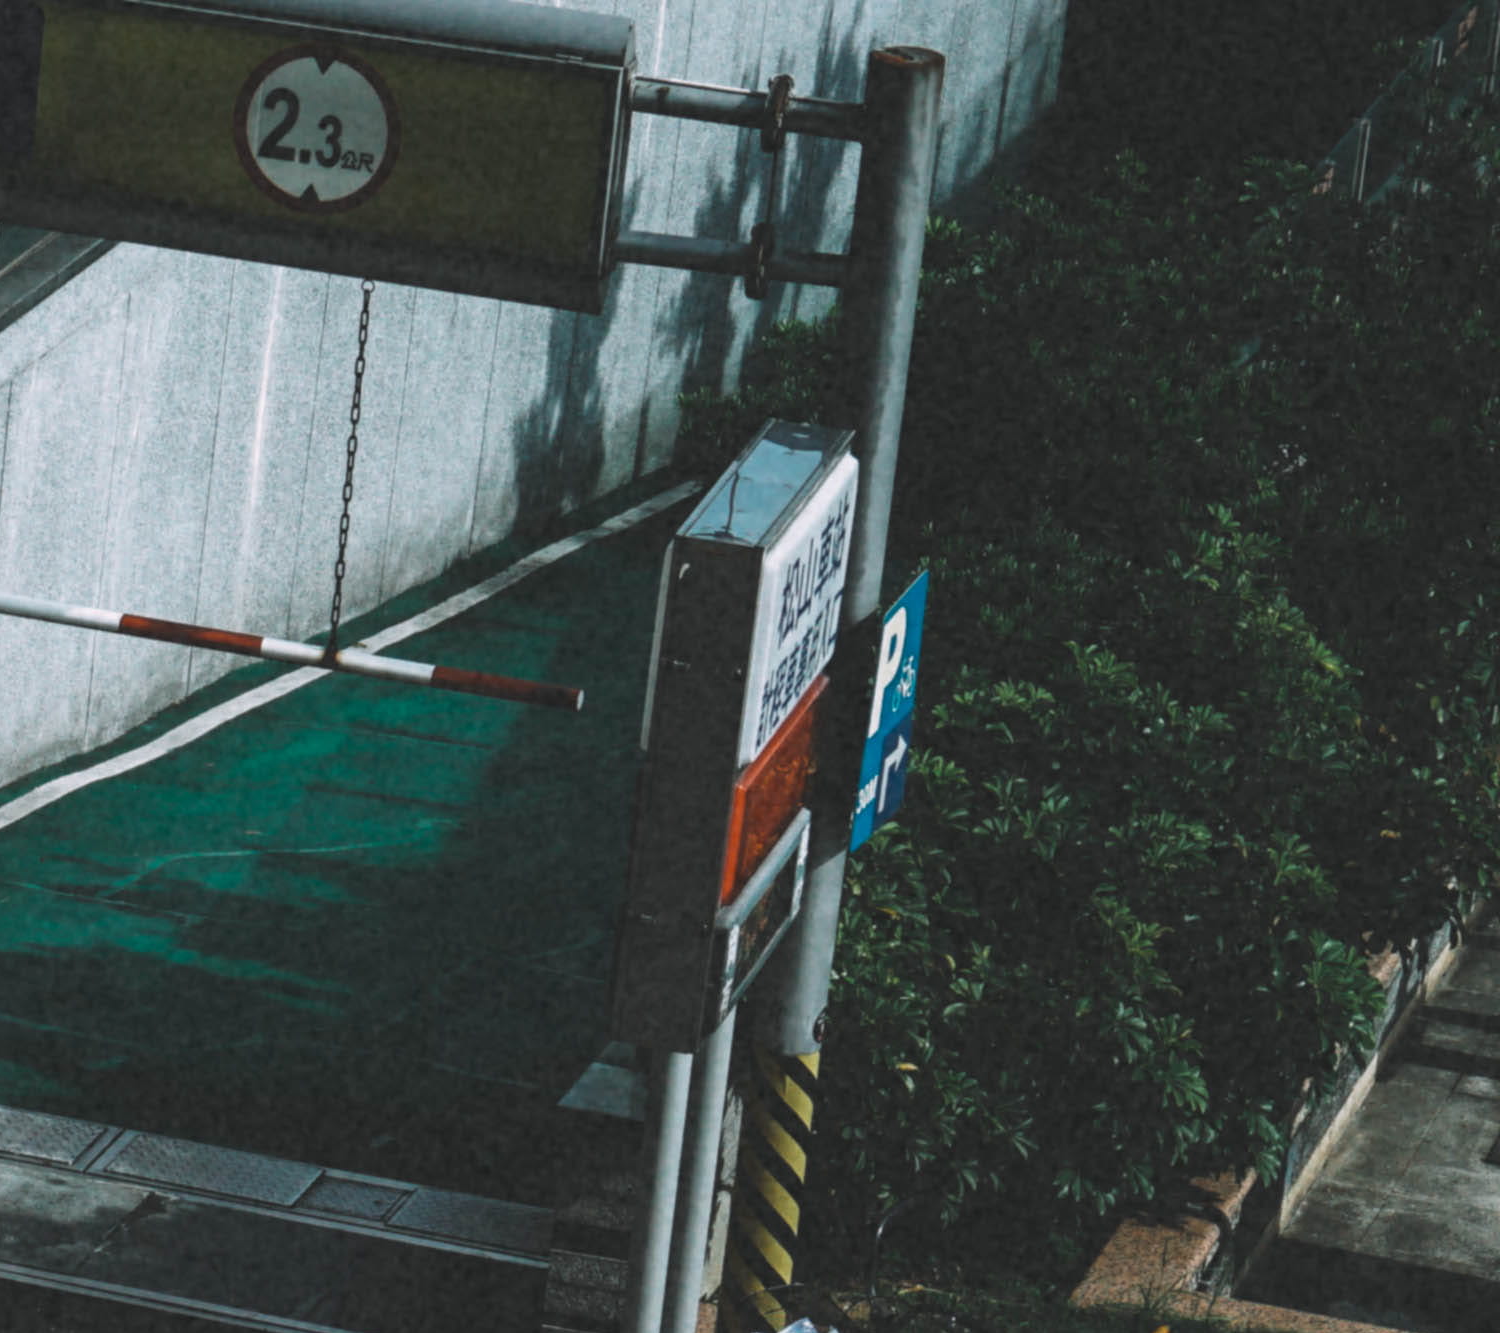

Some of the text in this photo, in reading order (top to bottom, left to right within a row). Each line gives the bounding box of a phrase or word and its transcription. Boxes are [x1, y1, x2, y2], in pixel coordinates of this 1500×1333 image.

[778, 493, 850, 648] 松山車站
[868, 606, 907, 738] P
